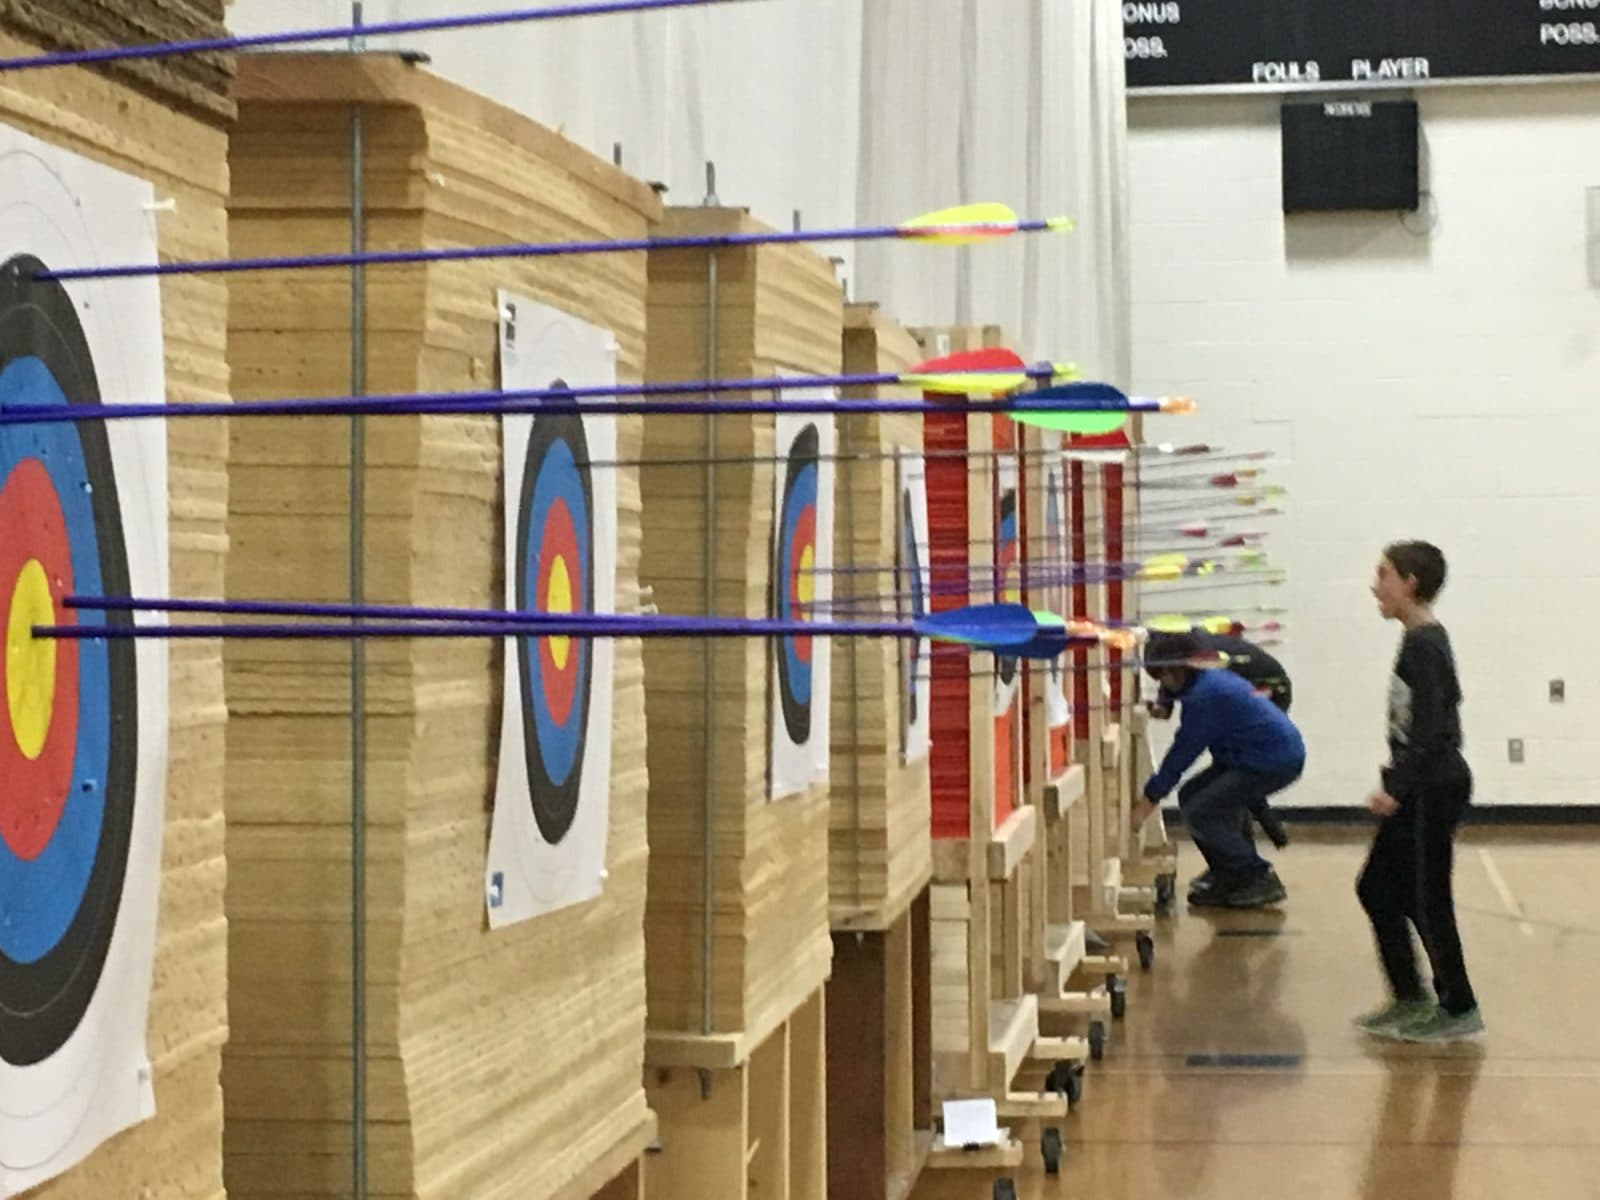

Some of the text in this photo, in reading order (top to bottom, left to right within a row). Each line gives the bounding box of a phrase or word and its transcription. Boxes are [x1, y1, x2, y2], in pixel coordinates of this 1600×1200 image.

[1122, 1, 1180, 24] ONUS
[1124, 36, 1168, 59] OSS.
[1252, 57, 1430, 83] FOULS PLAYER
